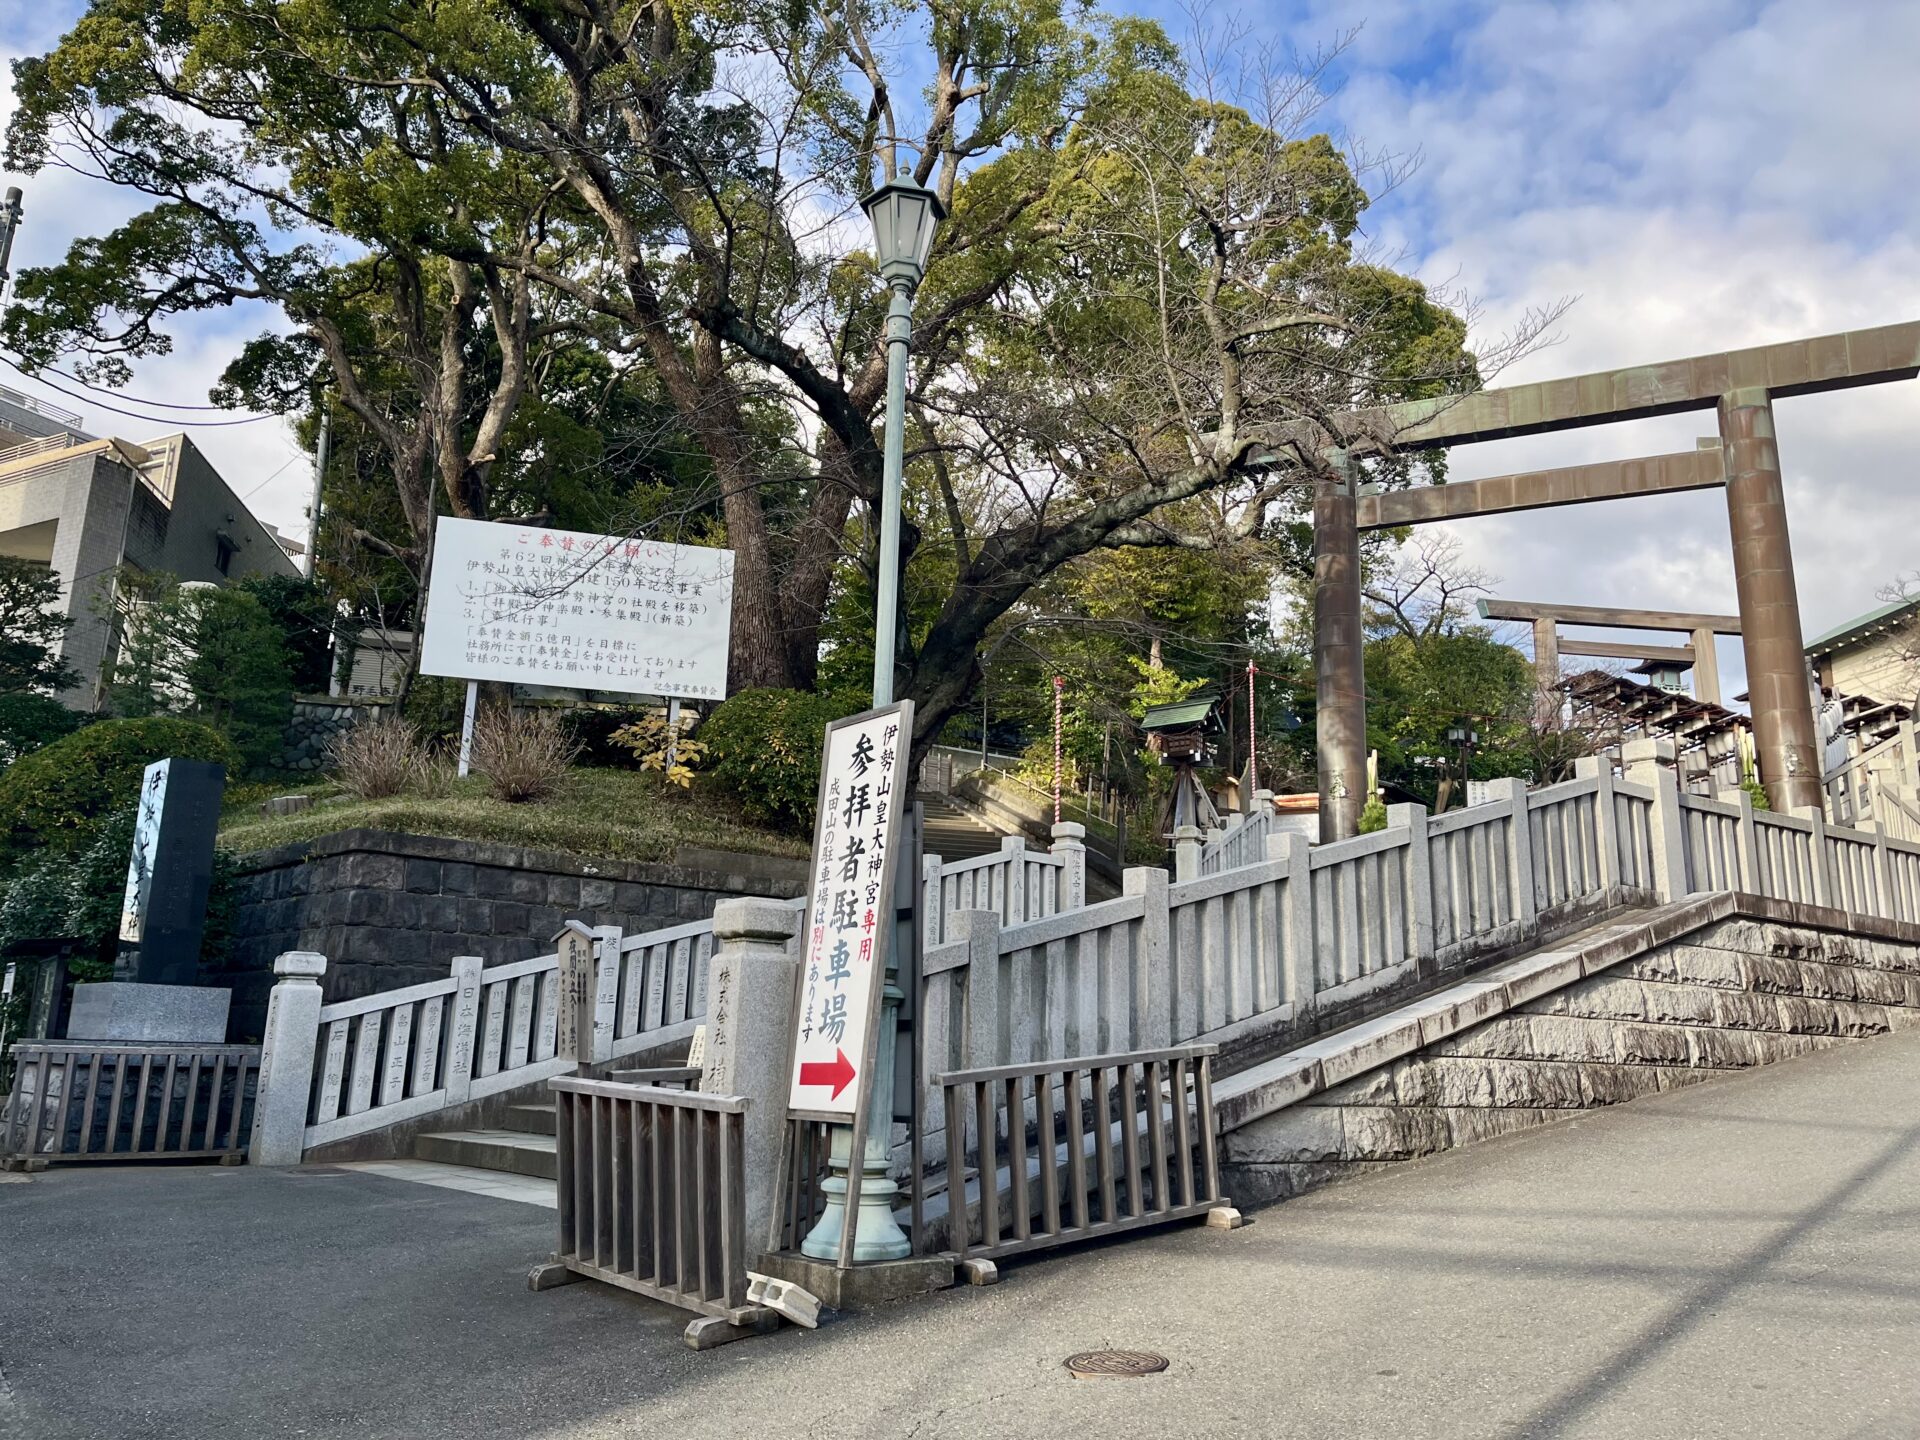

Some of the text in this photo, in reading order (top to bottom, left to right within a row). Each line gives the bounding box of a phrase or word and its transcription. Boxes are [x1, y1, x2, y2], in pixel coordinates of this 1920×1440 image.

[802, 778, 840, 1043] 成田山の駐車場は別にあります
[818, 733, 876, 1045] 参拝者駐車場
[858, 725, 898, 963] 伊勢山皇大神宮専用
